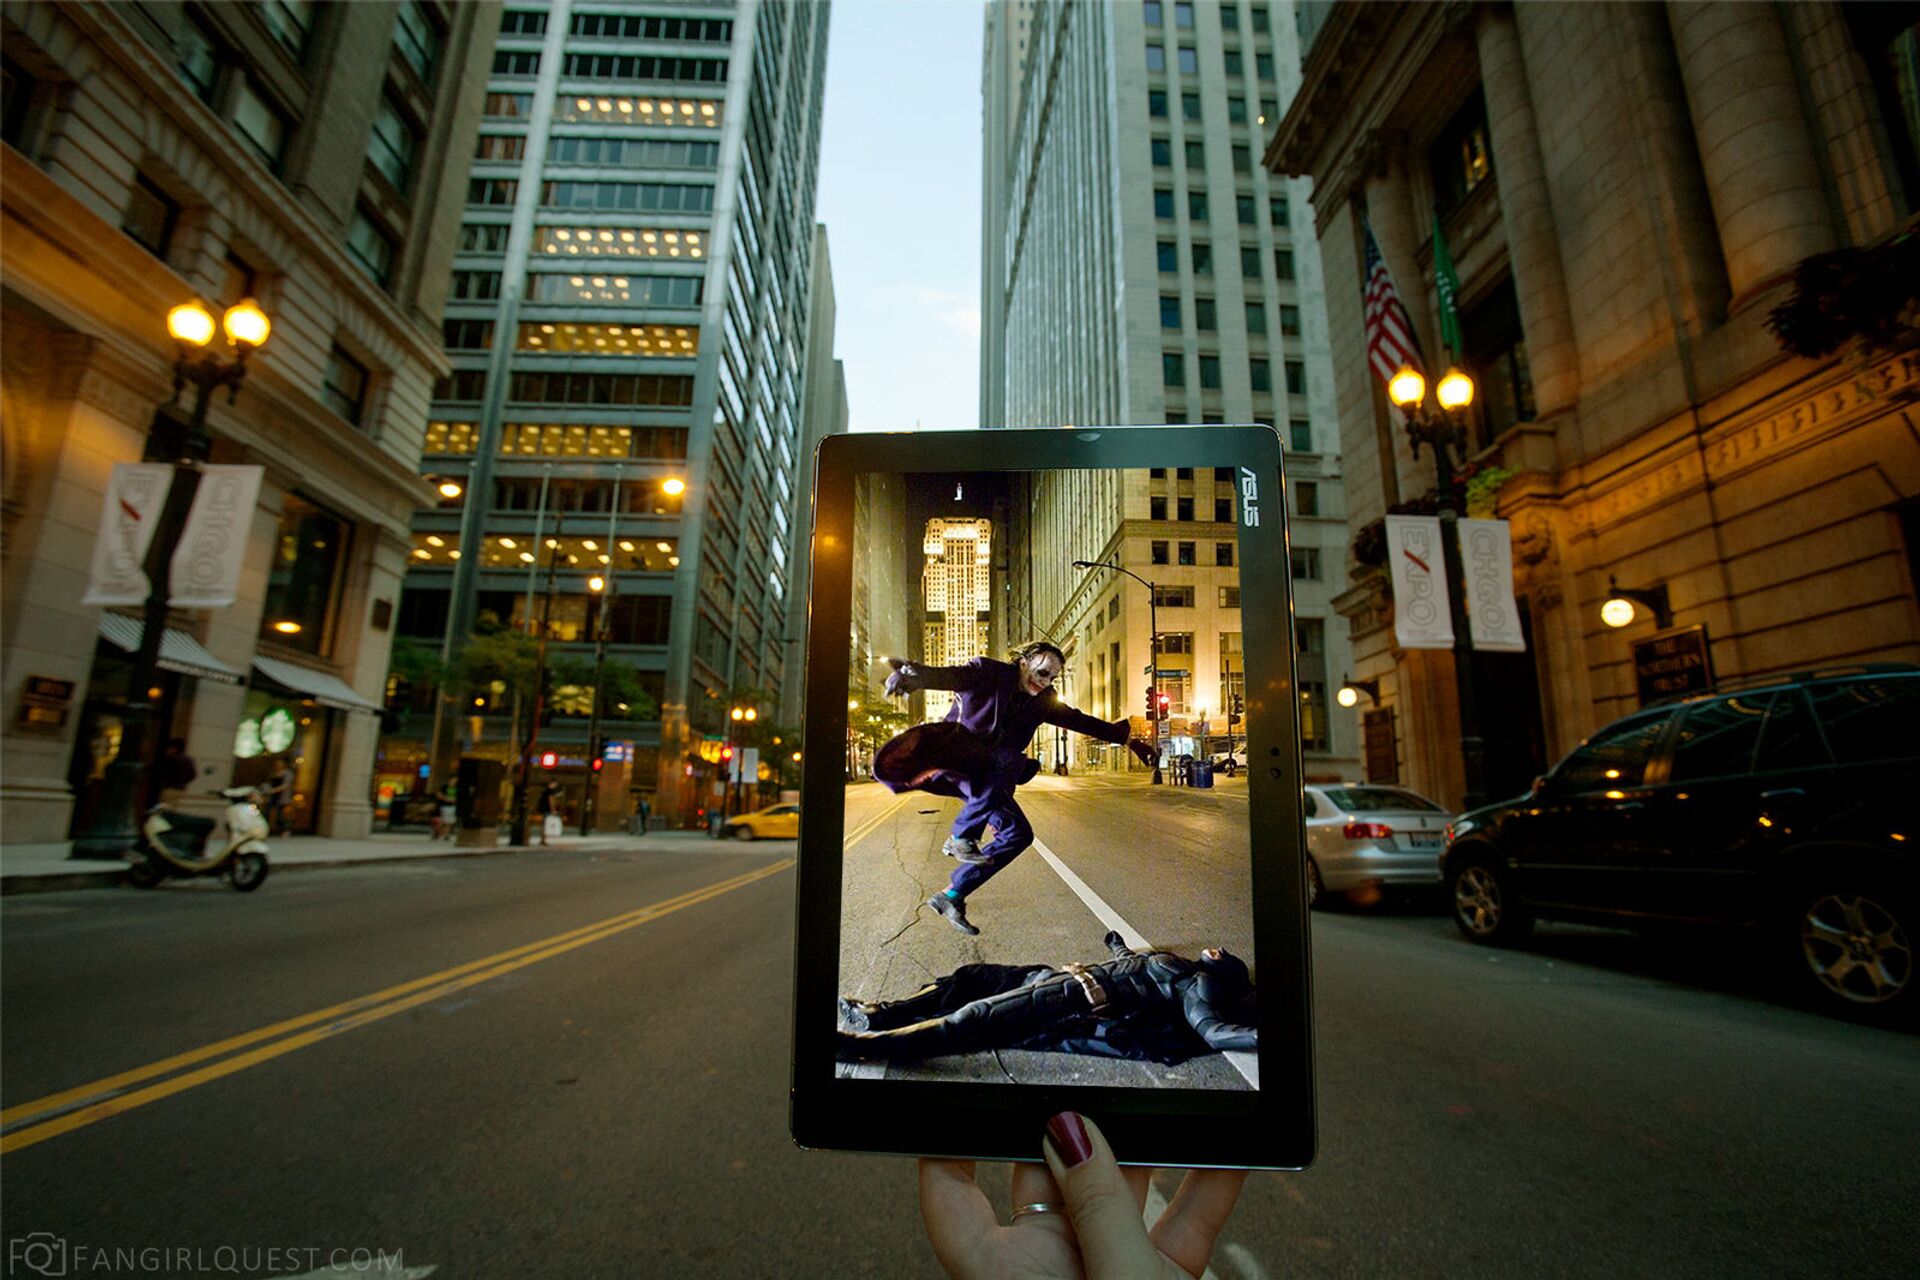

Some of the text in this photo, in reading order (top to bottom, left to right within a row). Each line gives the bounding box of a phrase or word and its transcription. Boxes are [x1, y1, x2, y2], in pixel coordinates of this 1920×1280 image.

[1241, 466, 1259, 527] ASUS
[1401, 525, 1437, 626] EXPO
[1470, 527, 1506, 631] CHGO
